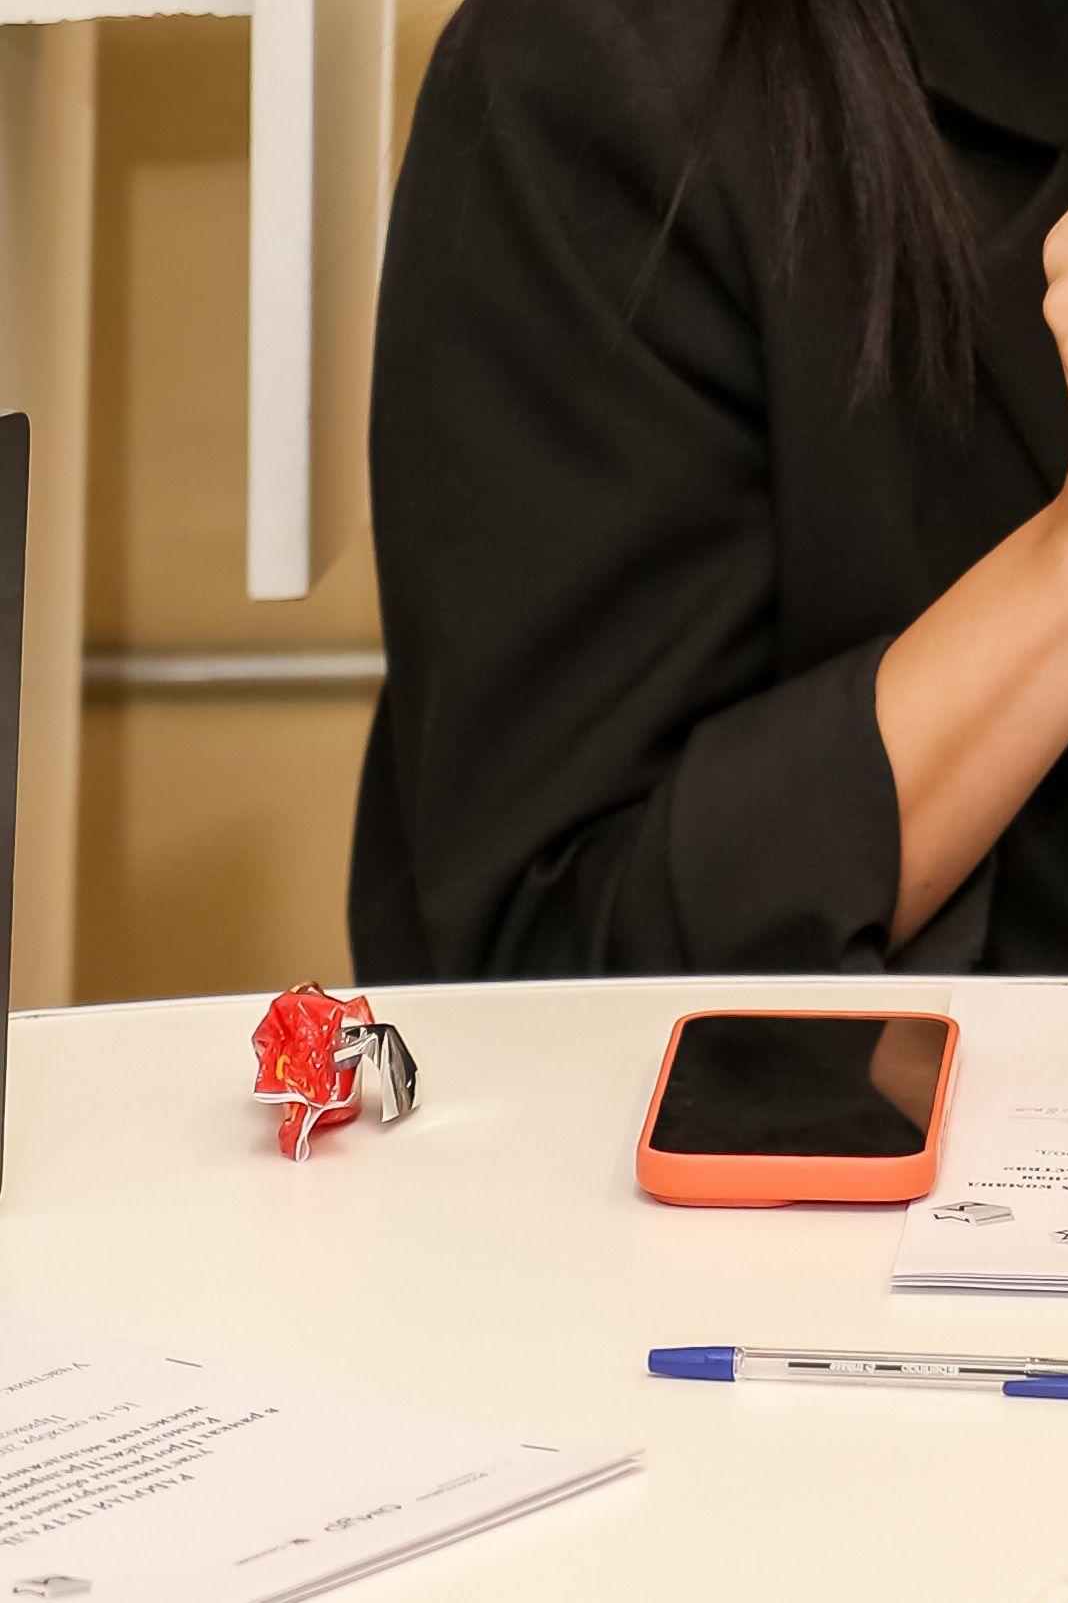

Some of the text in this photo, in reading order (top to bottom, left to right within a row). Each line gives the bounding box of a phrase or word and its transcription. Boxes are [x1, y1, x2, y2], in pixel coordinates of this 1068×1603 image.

[967, 1181, 1052, 1190] команд
[20, 1420, 89, 1446] октября
[106, 1405, 208, 1445] экосистема
[198, 1411, 265, 1439] рамках
[90, 1439, 203, 1480] Программы
[118, 1448, 213, 1485] участника
[4, 1478, 90, 1511] обучения
